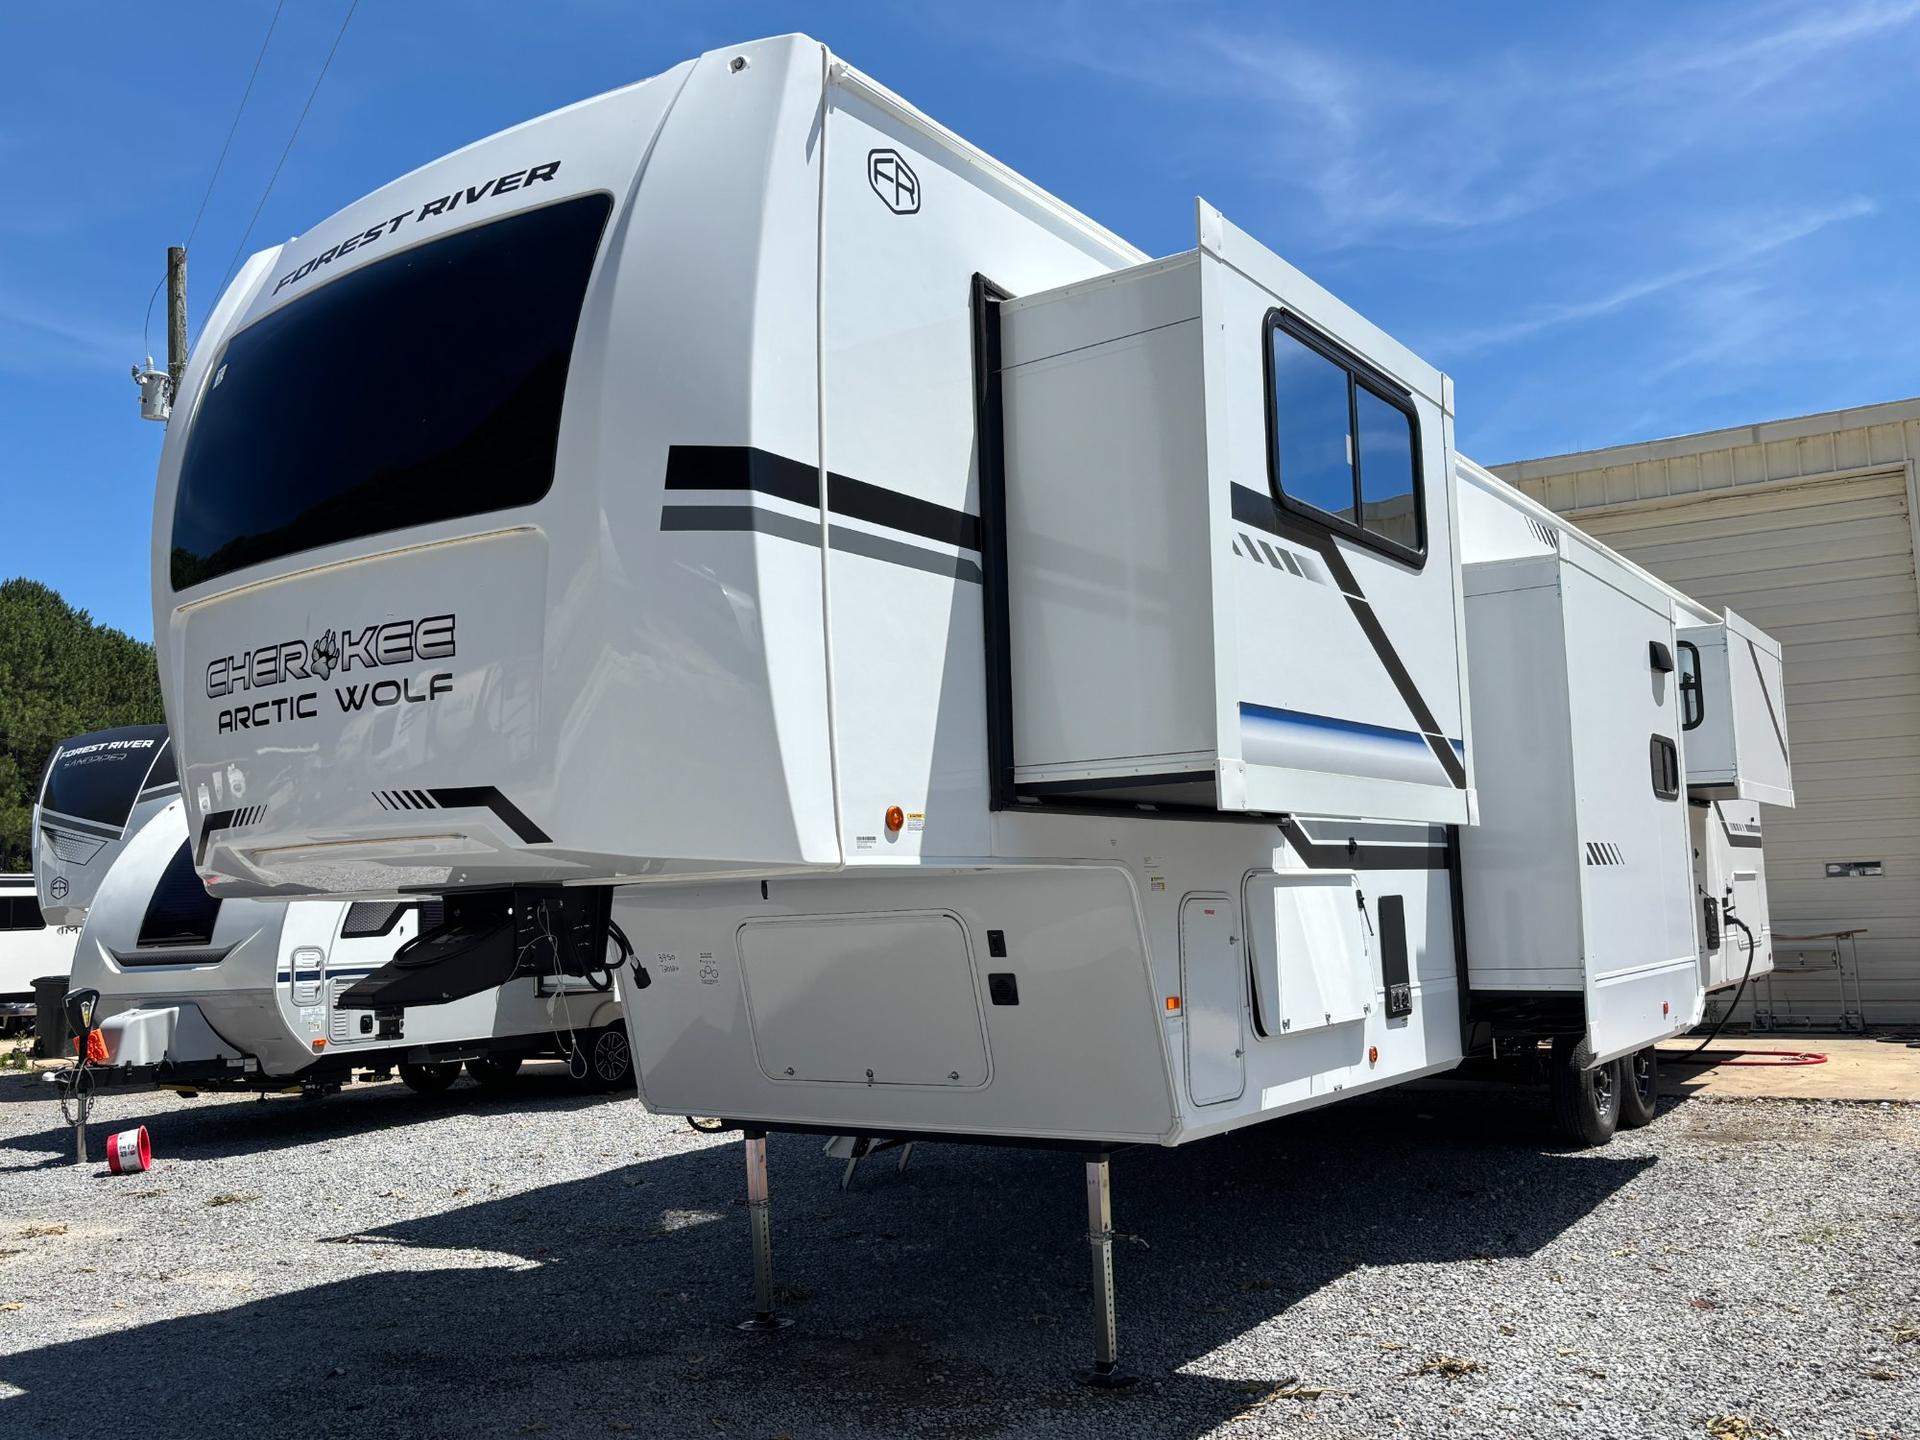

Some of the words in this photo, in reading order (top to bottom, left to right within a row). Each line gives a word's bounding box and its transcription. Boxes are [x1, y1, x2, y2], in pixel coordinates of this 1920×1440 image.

[272, 209, 414, 296] FOREST
[416, 160, 562, 222] RIVER
[218, 692, 318, 735] ARCTIC
[334, 672, 453, 713] WOLF
[59, 742, 109, 760] FOREST
[107, 739, 155, 751] RIVER
